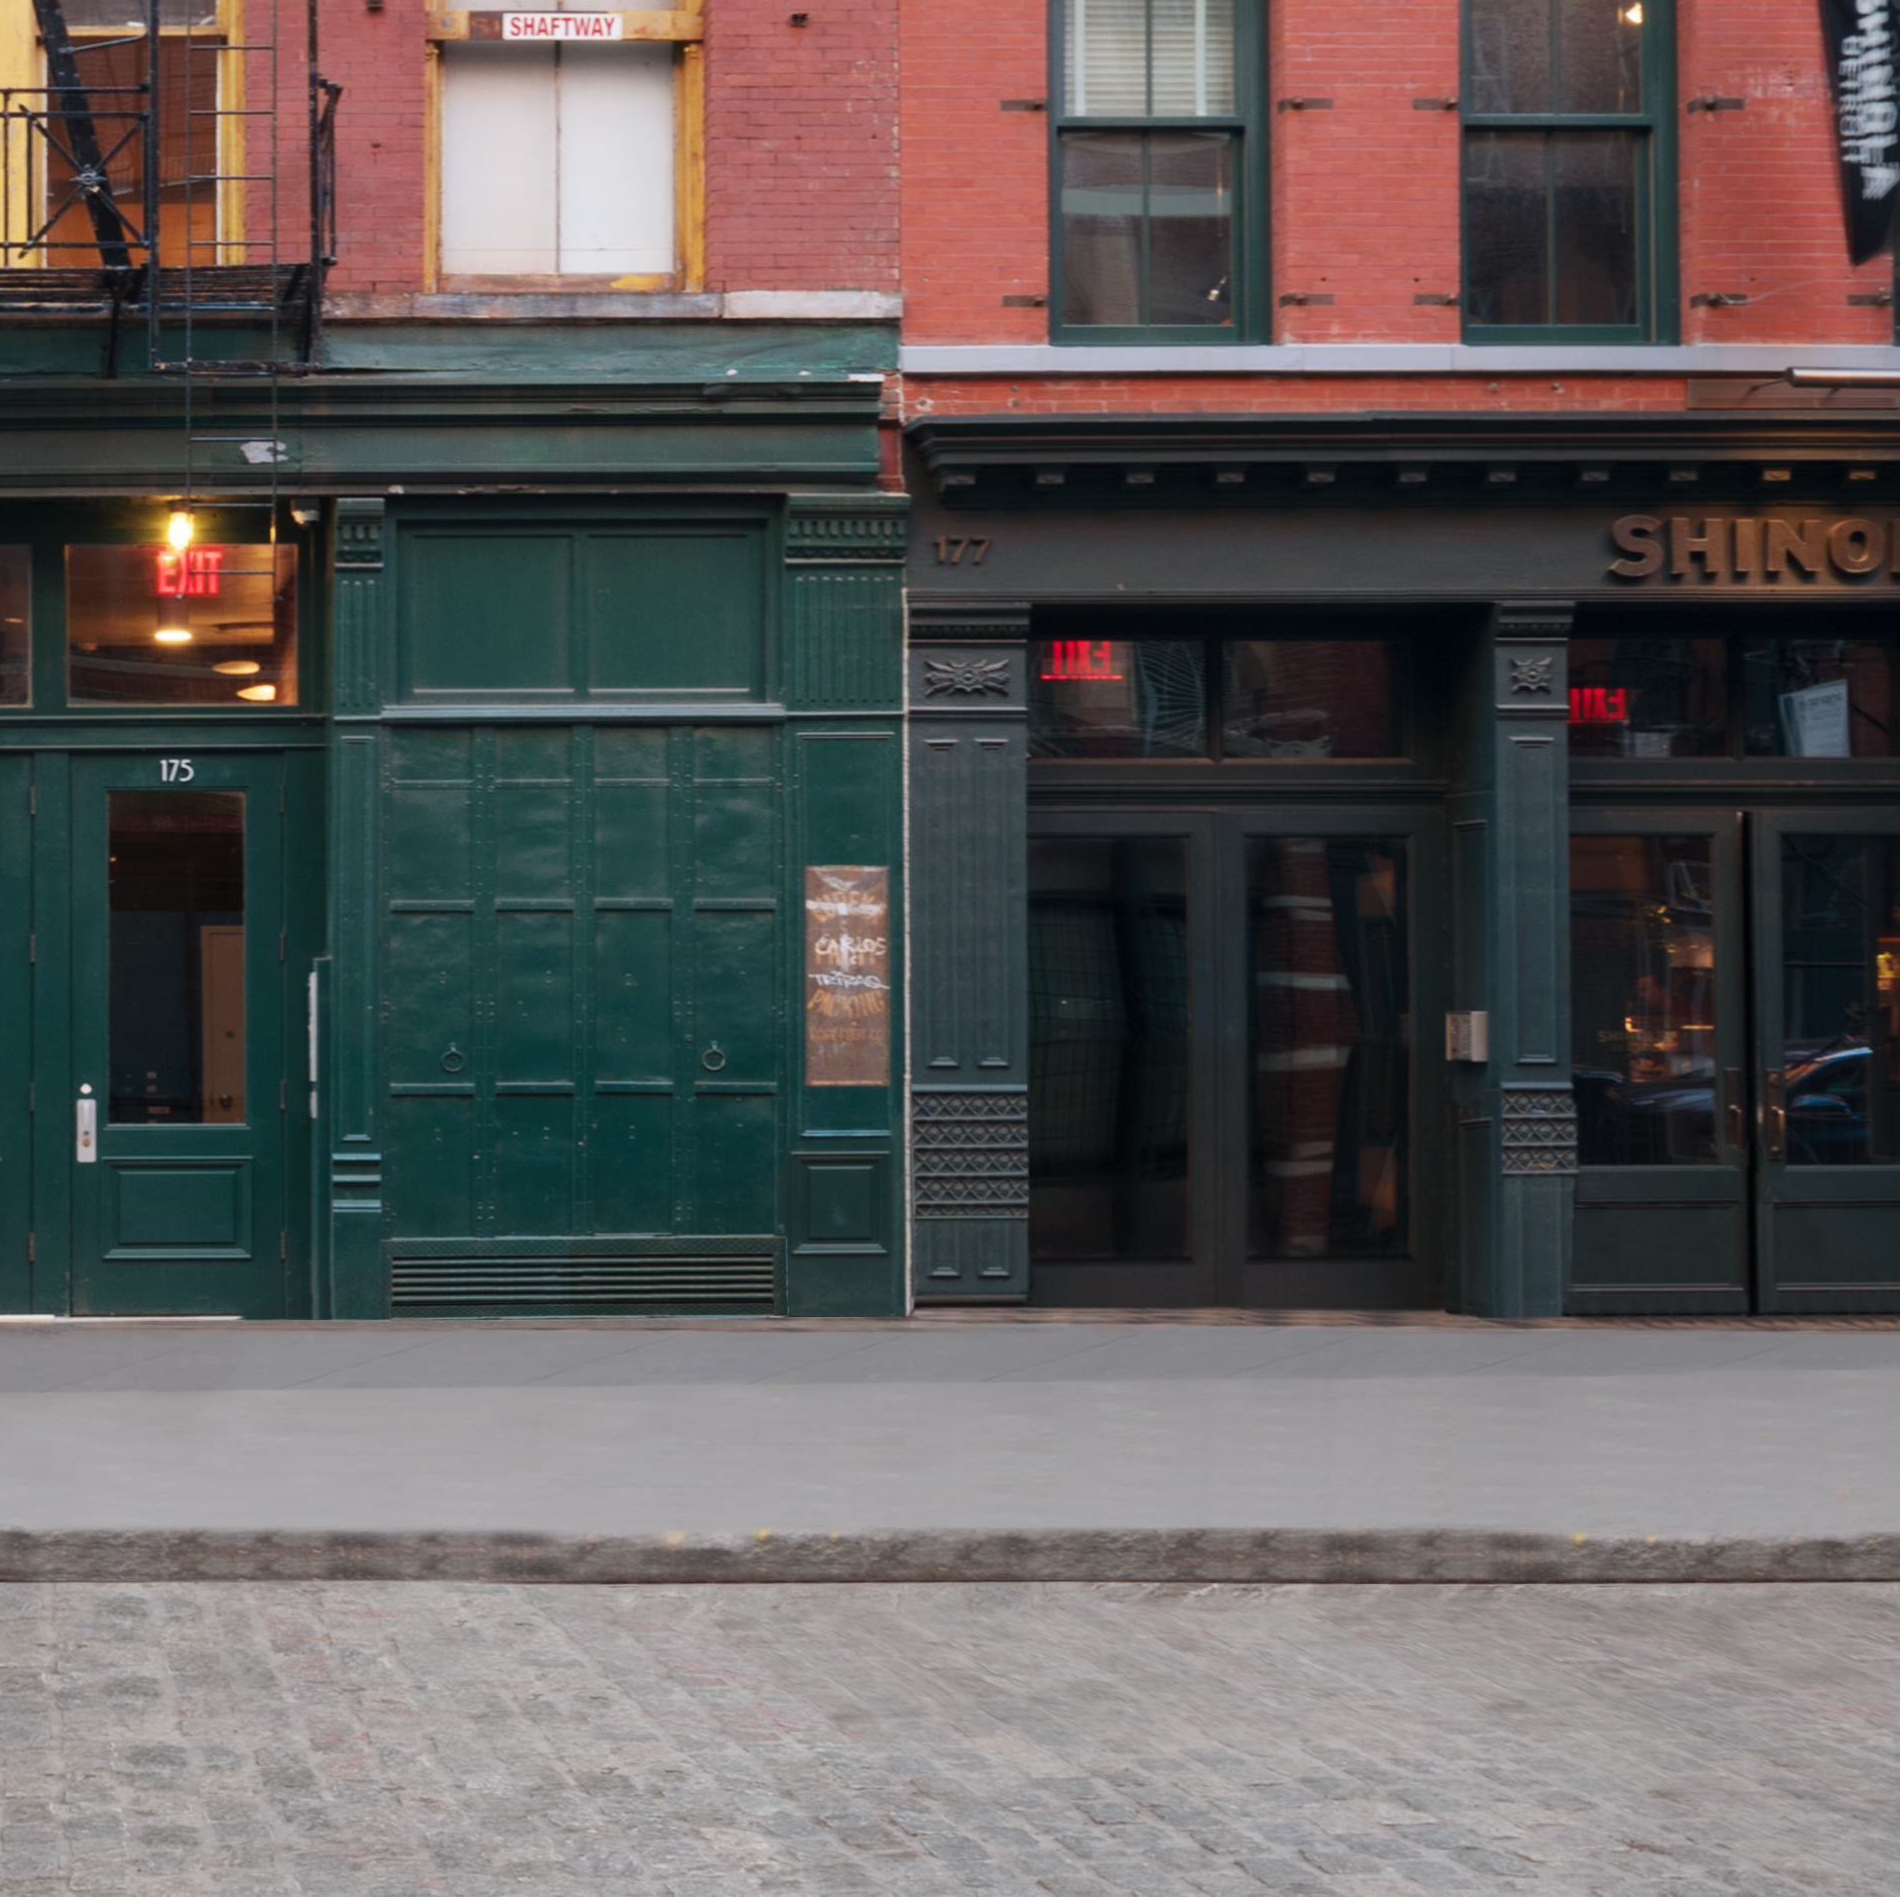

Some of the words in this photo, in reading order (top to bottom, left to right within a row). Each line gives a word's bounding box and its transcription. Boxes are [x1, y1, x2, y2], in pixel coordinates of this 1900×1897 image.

[509, 16, 615, 37] SHAFTWAY
[933, 535, 992, 564] 177
[1608, 514, 1900, 578] SHINO
[157, 551, 222, 594] EXIT
[159, 758, 195, 783] 175
